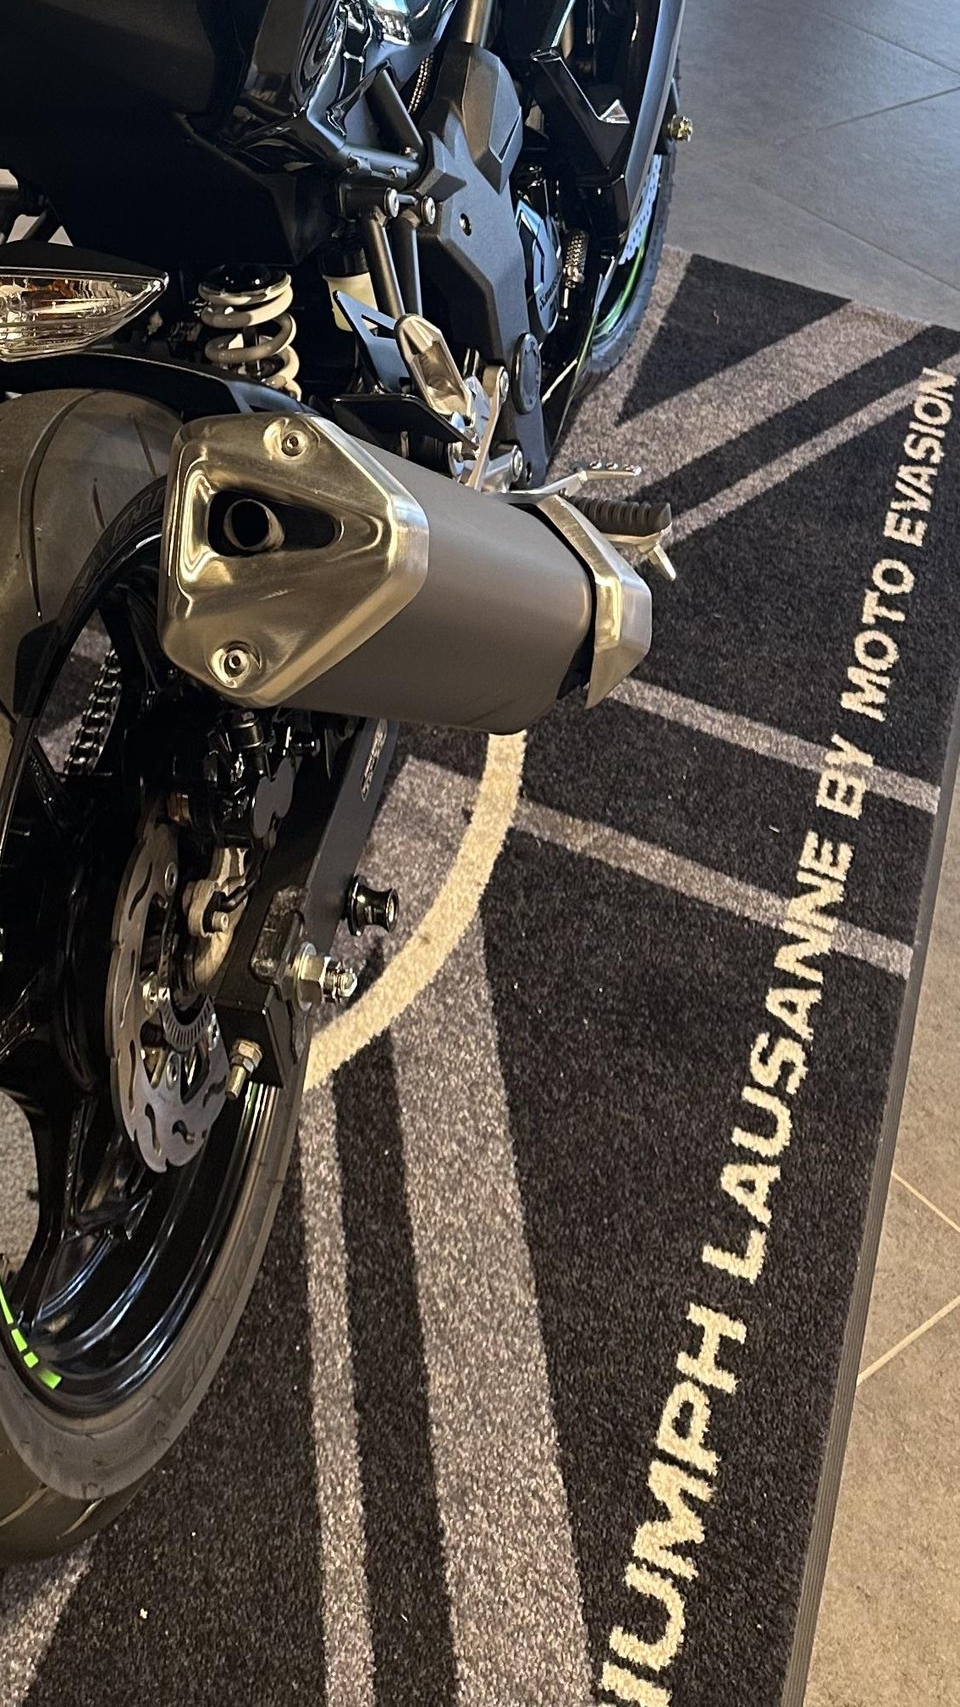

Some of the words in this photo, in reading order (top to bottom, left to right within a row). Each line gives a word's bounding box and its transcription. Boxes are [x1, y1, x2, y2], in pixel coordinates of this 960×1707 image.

[883, 367, 958, 547] EVASION
[839, 558, 916, 723] MOTO
[816, 733, 874, 822] BY
[701, 829, 854, 1285] LAUSANNE
[591, 1300, 748, 1707] IUMPH
